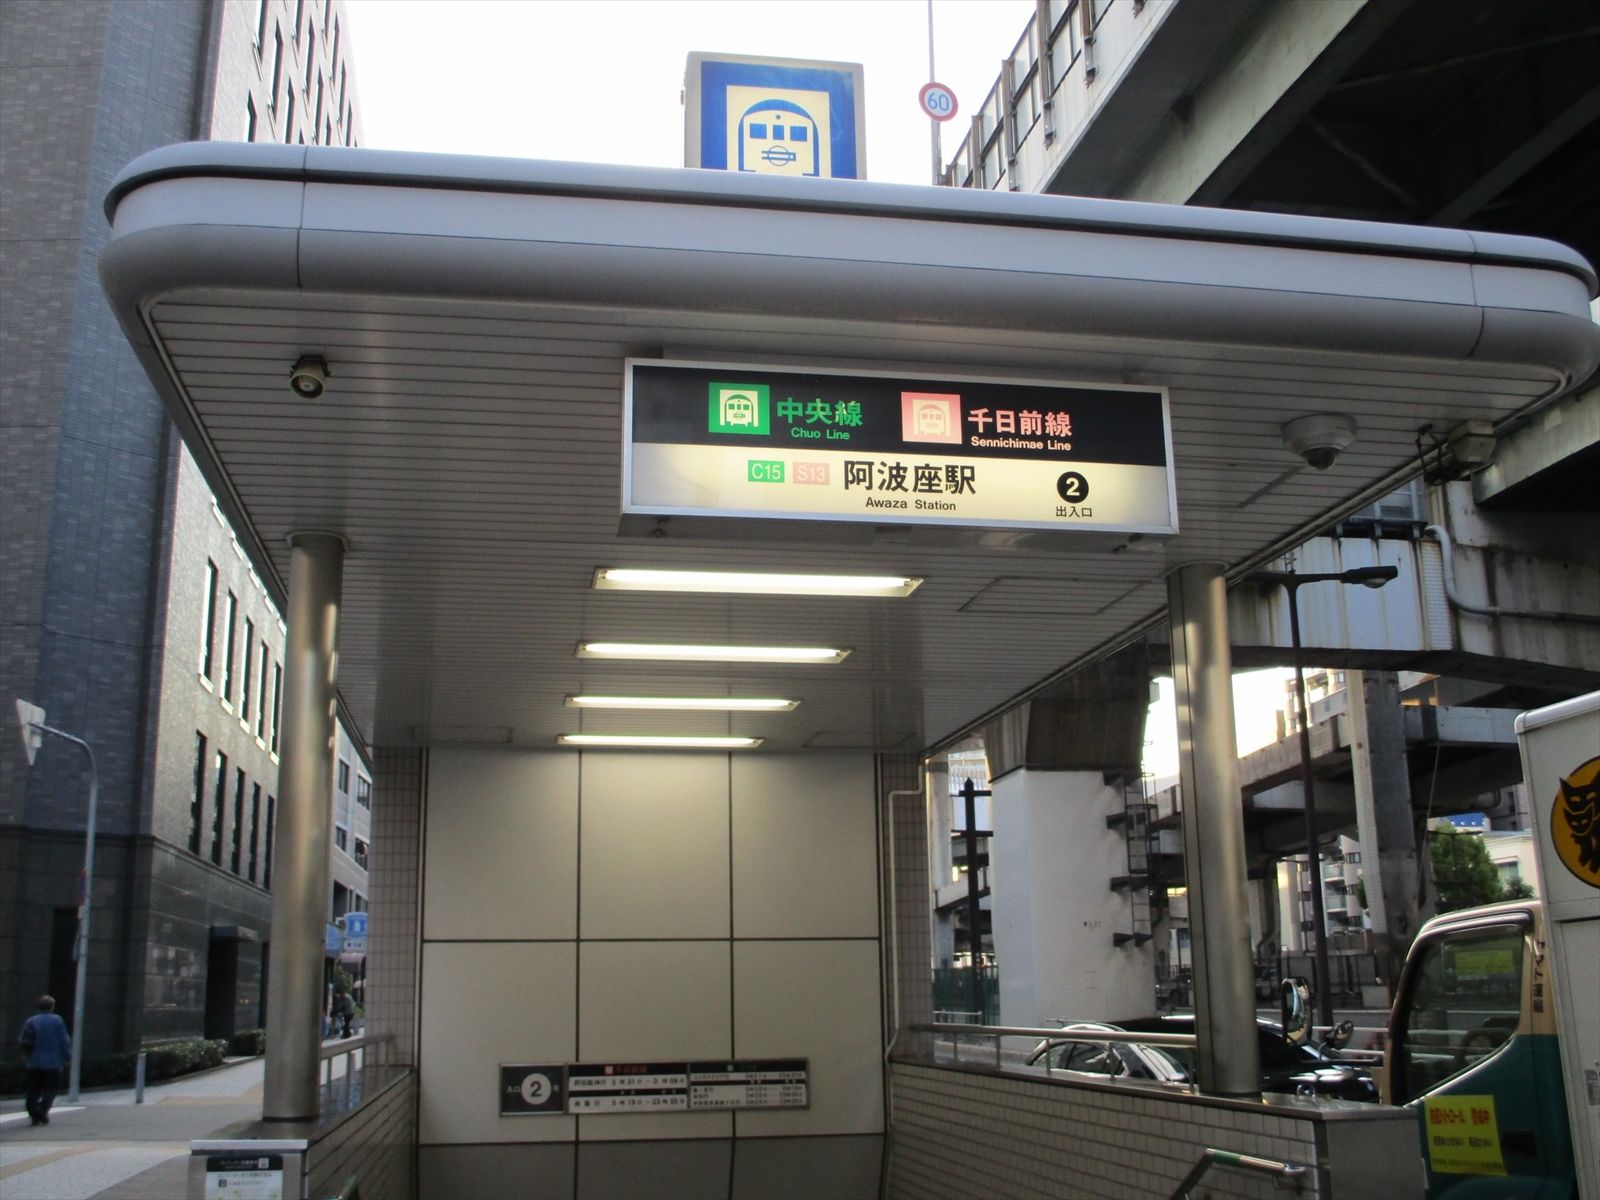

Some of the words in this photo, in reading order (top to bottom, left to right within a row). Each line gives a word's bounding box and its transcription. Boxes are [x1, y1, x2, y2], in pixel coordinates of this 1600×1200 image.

[927, 93, 949, 111] 60
[776, 397, 863, 427] 中央線
[967, 408, 1072, 437] 千日前線
[791, 427, 821, 439] Chuo
[826, 429, 850, 440] Line
[970, 436, 1043, 450] Sennichimae
[1048, 440, 1072, 451] Line
[751, 462, 782, 481] C15
[796, 464, 827, 483] S13
[843, 460, 977, 496] 阿波座駅
[1065, 478, 1081, 496] 2
[865, 497, 908, 510] Awaza
[915, 499, 957, 511] Station
[1055, 505, 1093, 518] 出入口
[530, 1080, 542, 1097] 2
